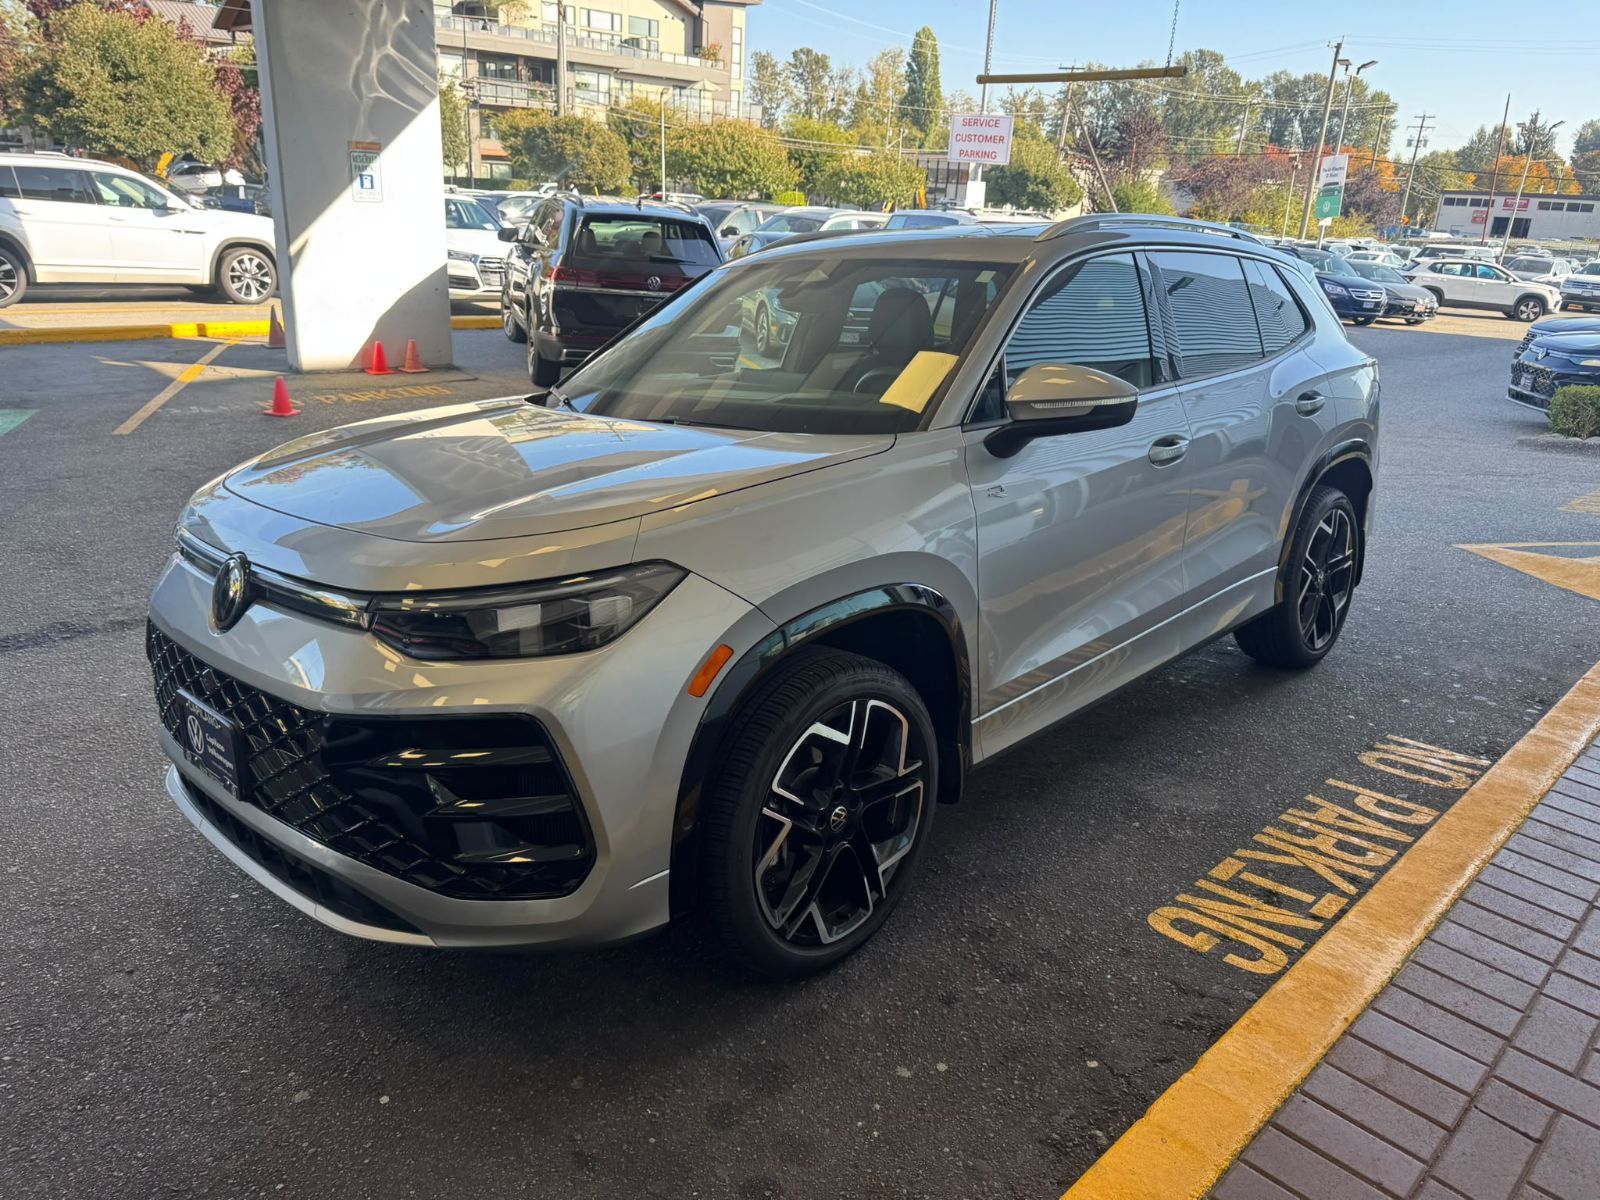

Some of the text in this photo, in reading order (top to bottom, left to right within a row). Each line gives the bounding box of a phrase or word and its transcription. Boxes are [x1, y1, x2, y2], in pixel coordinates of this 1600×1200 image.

[962, 117, 1001, 128] SERVICE
[955, 133, 1005, 144] CUSTOMER
[959, 149, 997, 160] PARKING
[315, 384, 451, 405] PARKING
[1147, 734, 1492, 975] NO PARKING
